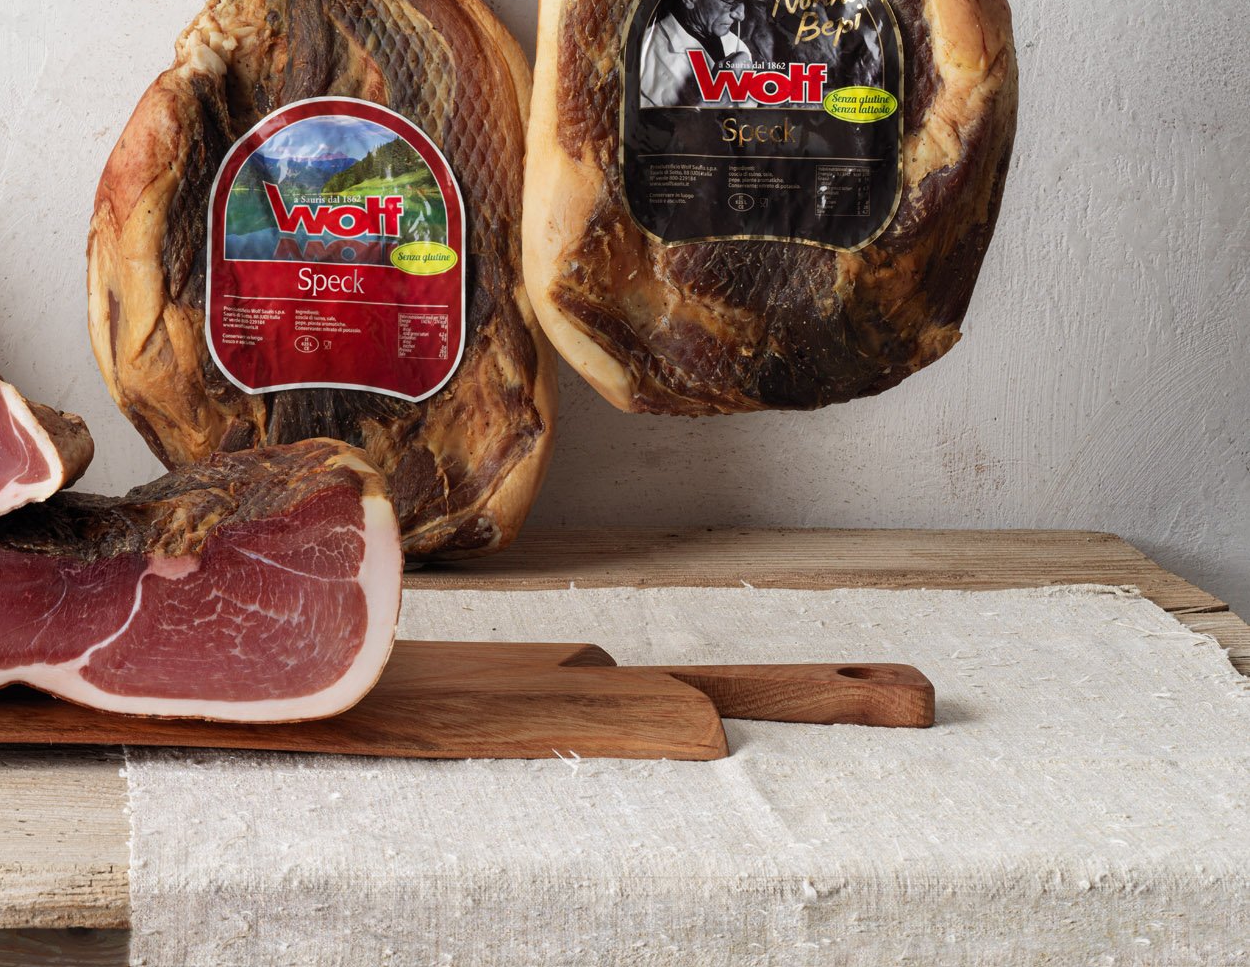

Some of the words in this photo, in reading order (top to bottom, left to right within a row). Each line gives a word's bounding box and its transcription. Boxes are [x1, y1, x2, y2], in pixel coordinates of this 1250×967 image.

[794, 3, 862, 47] Bepi
[725, 60, 751, 70] Sauris
[752, 61, 765, 70] dal
[767, 62, 787, 70] 1862
[686, 49, 828, 105] Wolf
[831, 93, 857, 103] Senza
[858, 95, 890, 107] glutine
[831, 104, 857, 114] Senza
[858, 103, 891, 114] lattosio
[721, 117, 797, 147] Speck
[262, 180, 404, 239] Wolf
[300, 195, 326, 204] Sauris
[327, 196, 341, 204] dal
[342, 195, 362, 204] 1862
[396, 251, 422, 262] Senza
[422, 251, 451, 264] glutine
[297, 267, 366, 297] Speck
